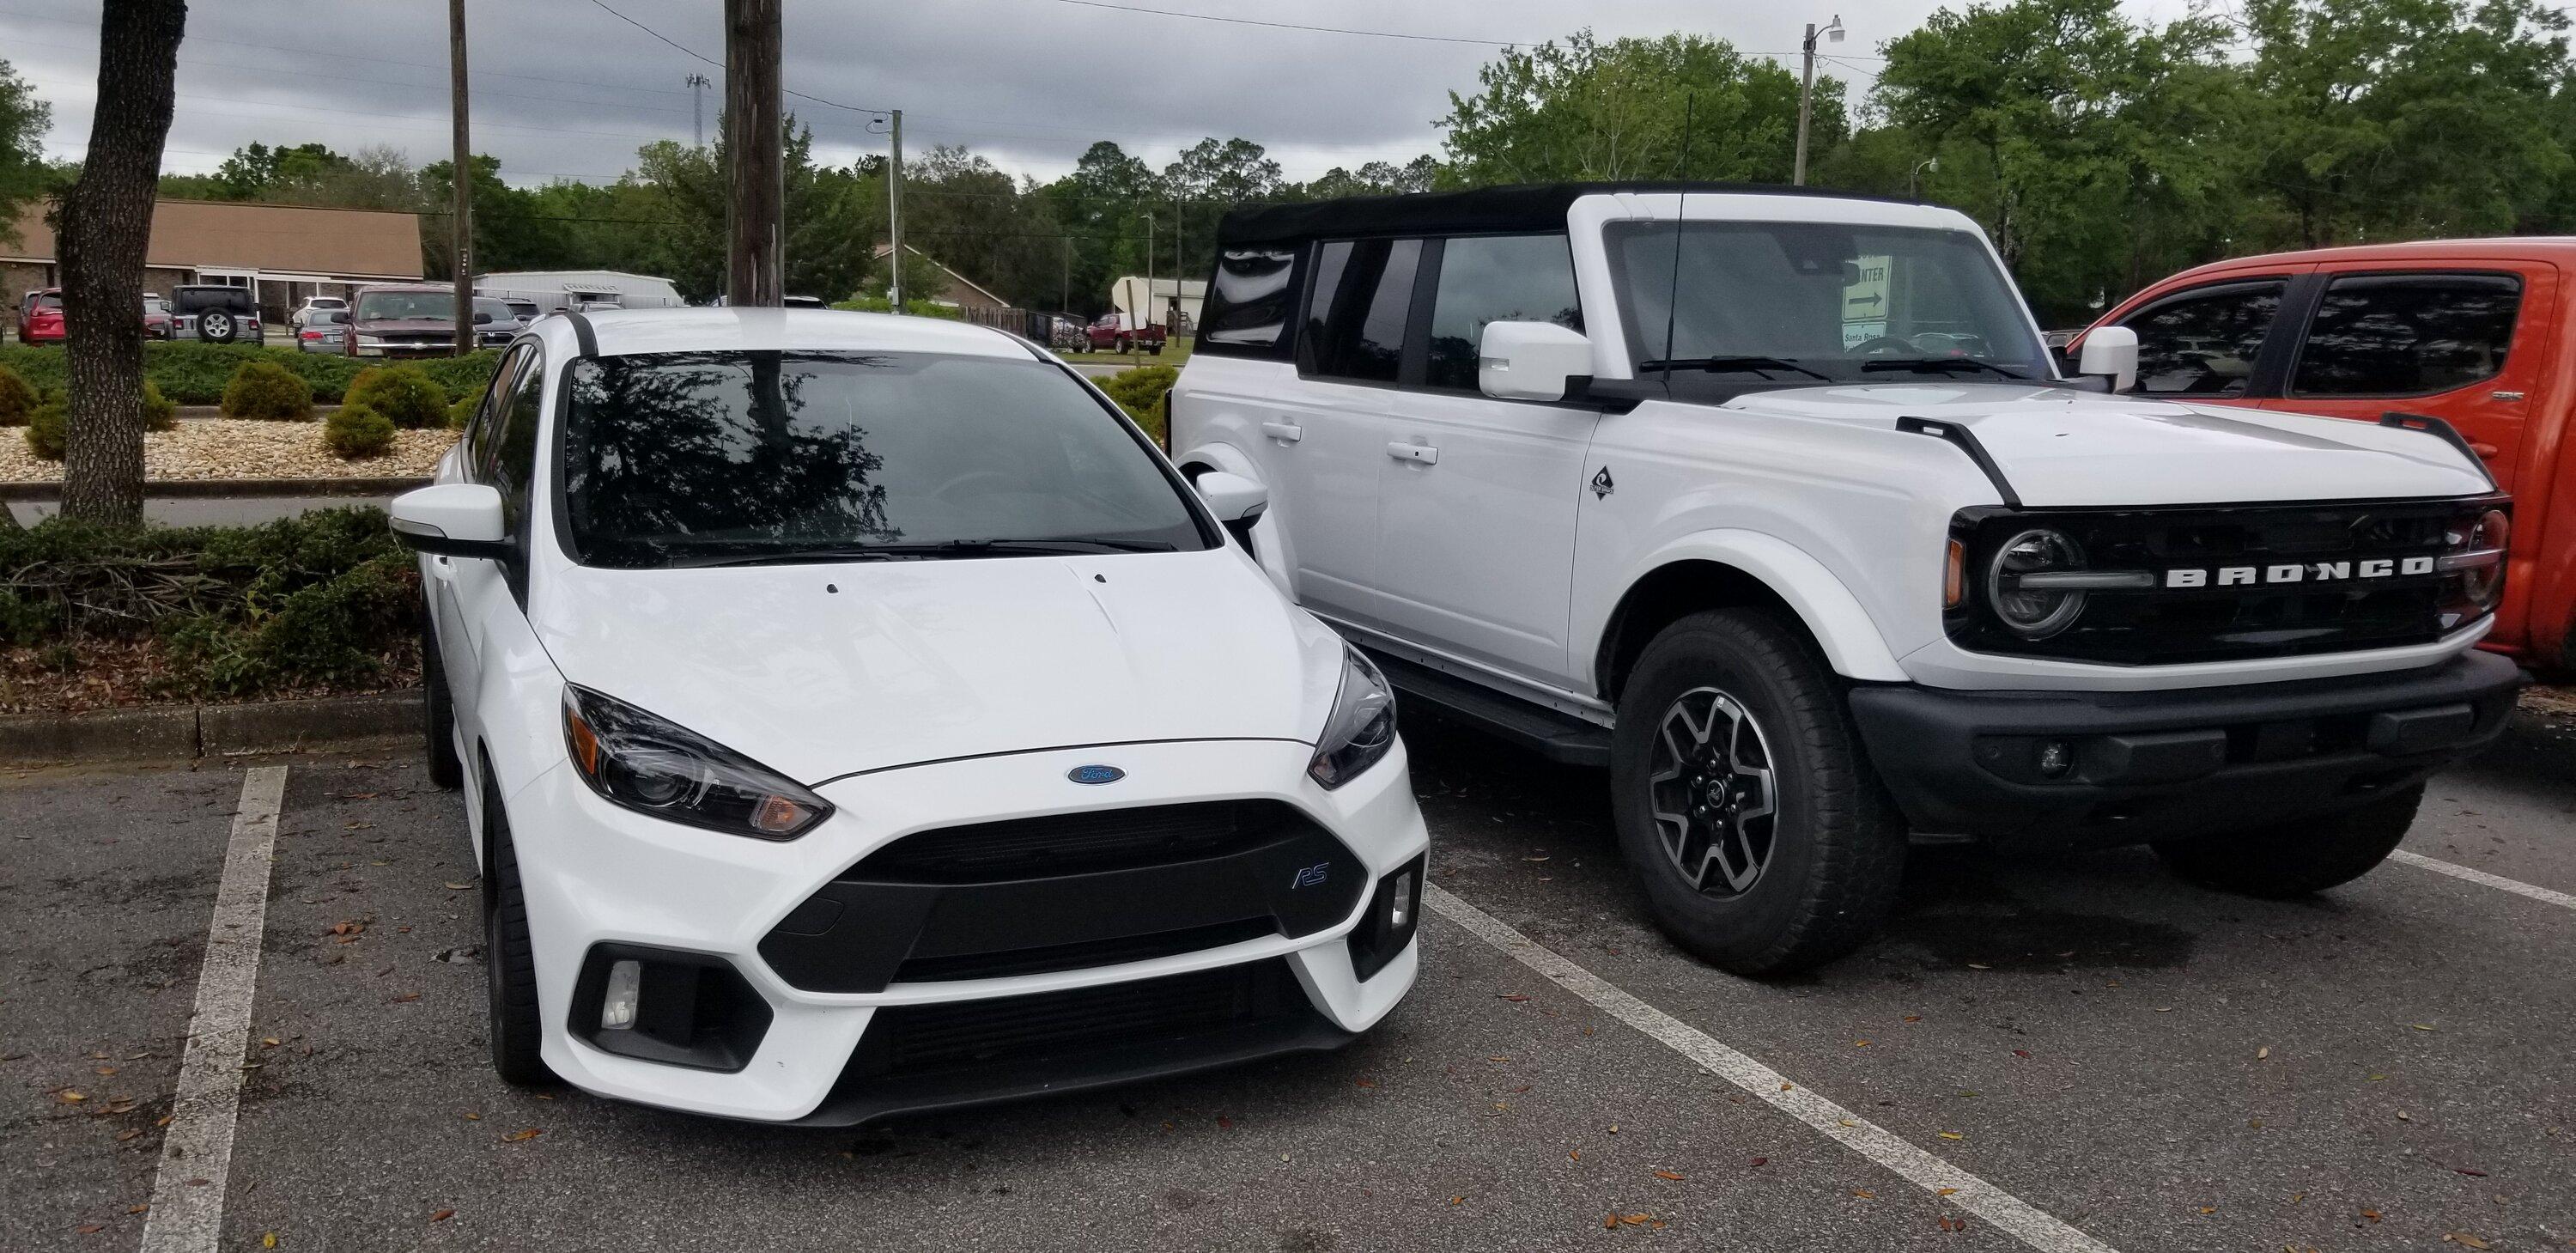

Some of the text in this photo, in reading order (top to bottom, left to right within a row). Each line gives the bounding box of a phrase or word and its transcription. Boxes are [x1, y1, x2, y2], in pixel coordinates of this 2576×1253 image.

[1861, 267, 1884, 283] NTER
[1844, 333, 1862, 342] Santa
[2166, 556, 2434, 588] BRONCO
[1291, 861, 1329, 890] RS
